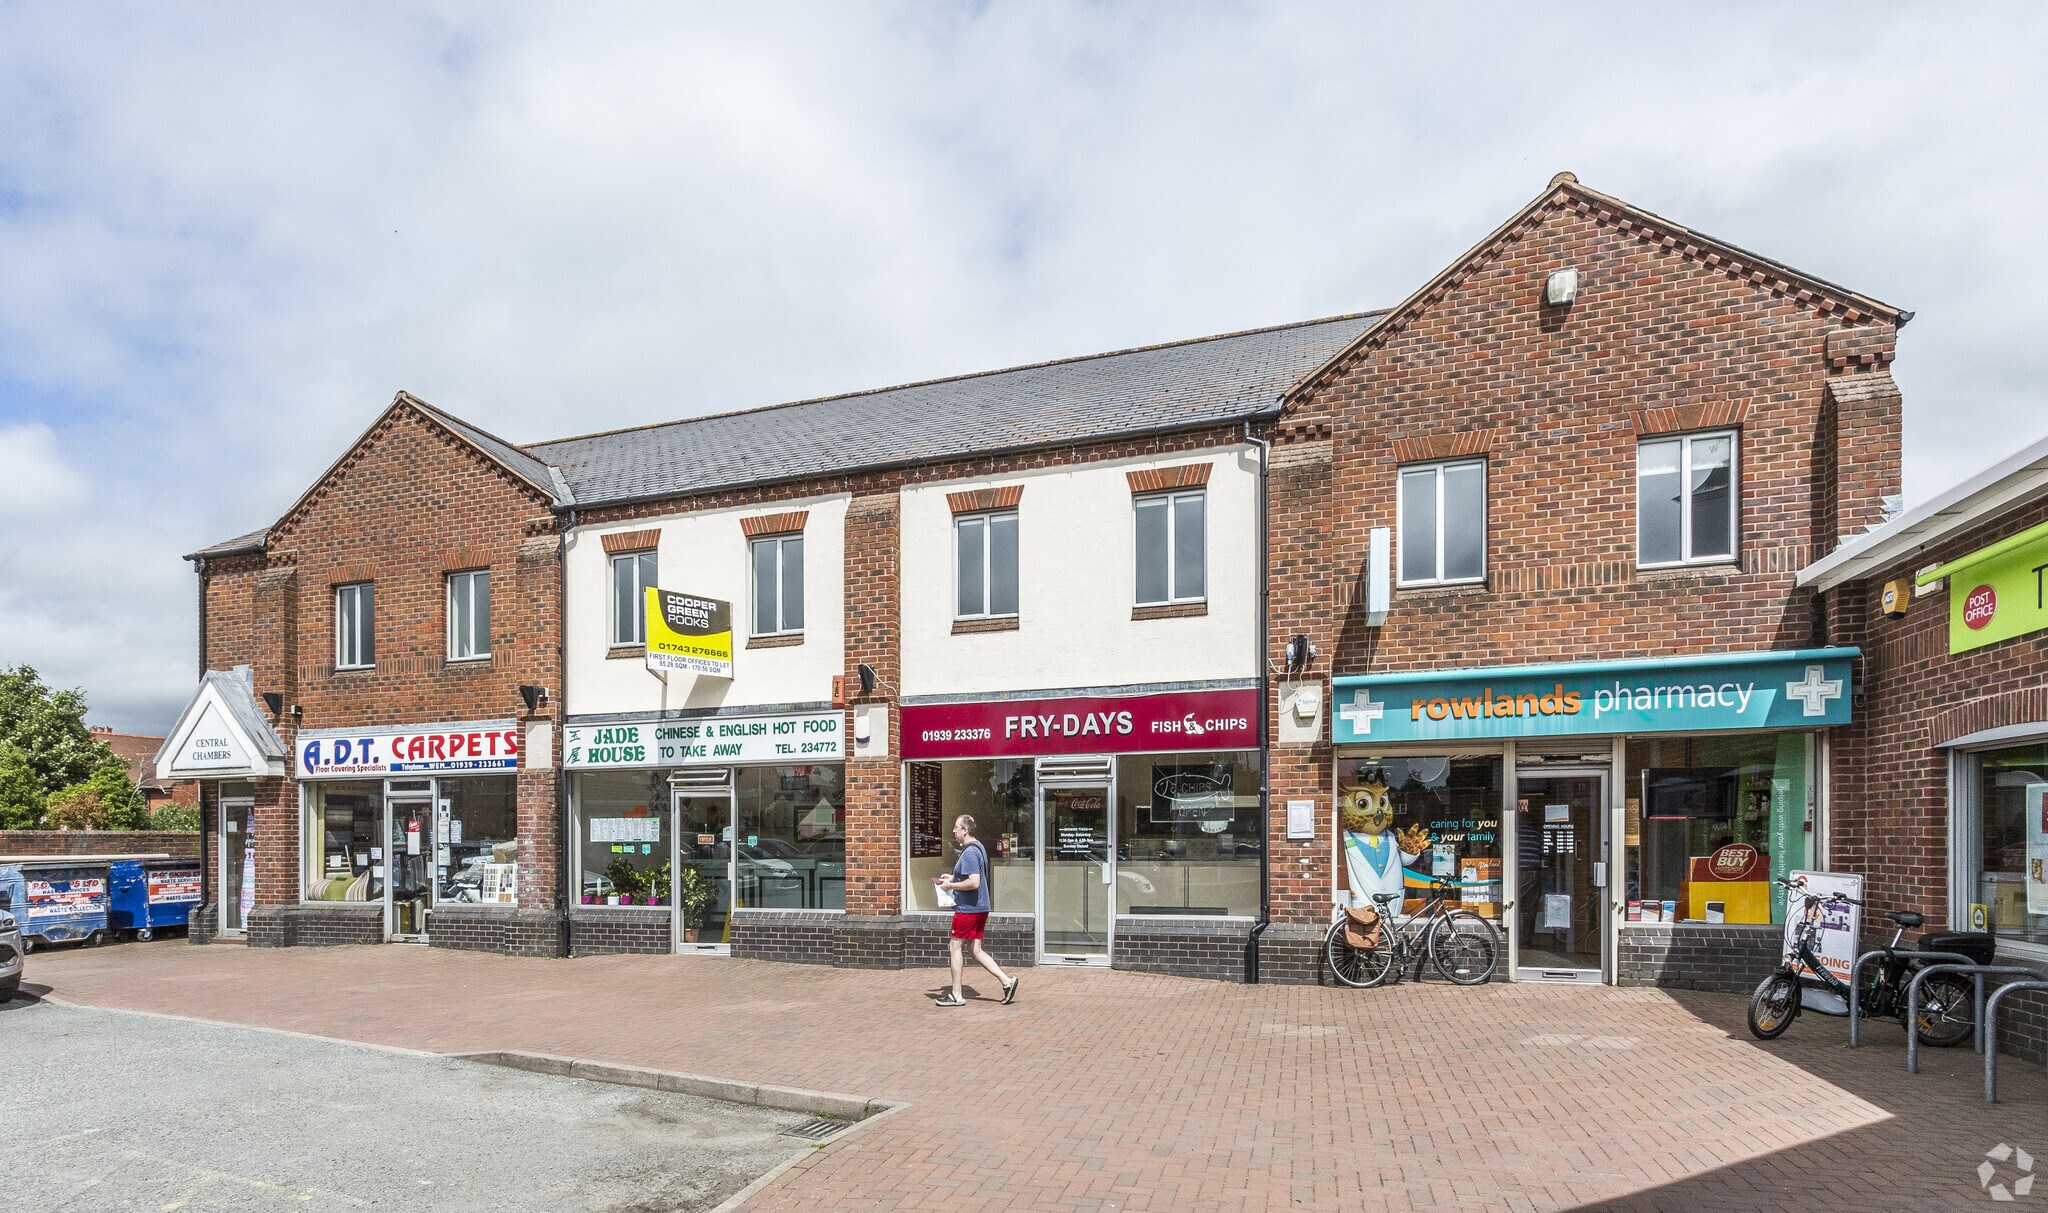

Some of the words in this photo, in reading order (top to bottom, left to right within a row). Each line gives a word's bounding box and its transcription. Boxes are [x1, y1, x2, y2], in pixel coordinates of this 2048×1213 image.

[666, 595, 717, 612] COOPER
[1969, 591, 1990, 609] POST
[667, 604, 709, 619] GREEN
[1965, 602, 1994, 622] OFFICE
[667, 614, 709, 628] POOKS
[658, 642, 690, 653] 01743
[691, 646, 728, 658] 276666
[649, 652, 665, 661] FIRST
[667, 655, 687, 663] FLOOR
[687, 657, 711, 666] OFFICES
[711, 659, 720, 667] TO
[719, 661, 730, 669] LET
[675, 662, 688, 670] SQM
[1411, 683, 1582, 721] rowlands
[1593, 681, 1755, 719] pharmacy
[655, 726, 700, 740] CHINESE
[706, 725, 714, 737] &
[719, 723, 767, 737] ENGLISH
[772, 721, 797, 735] HOT
[803, 719, 837, 733] FOOD
[1004, 711, 1134, 739] FRY-DAYS
[1151, 720, 1182, 733] FISH
[1205, 718, 1248, 731] CHIPS
[593, 727, 639, 745] JADE
[922, 729, 952, 742] 01939
[953, 728, 991, 741] 233376
[195, 738, 229, 748] CENTRAL
[660, 746, 675, 758] TO
[680, 745, 707, 758] TAKE
[713, 743, 743, 756] AWAY
[775, 743, 797, 754] TEL:
[801, 741, 837, 753] 234772
[192, 751, 232, 760] CHAMBERS
[303, 738, 379, 775] A.D.T.
[391, 731, 518, 761] CARPETS
[587, 745, 646, 763] HOUSE
[315, 765, 330, 773] Floor
[331, 765, 356, 773] Covering
[357, 764, 387, 773] Specialists
[450, 761, 473, 769] 01939
[478, 760, 506, 768] 233661
[1430, 819, 1459, 830] caring
[1461, 818, 1475, 828] for
[1477, 820, 1498, 830] you
[1777, 814, 1786, 831] with
[1430, 832, 1440, 842] &
[1440, 833, 1465, 843] your
[1467, 832, 1495, 843] family
[1776, 831, 1786, 849] your
[1720, 849, 1753, 857] BEST
[1716, 857, 1749, 867] BUY
[1815, 955, 1850, 970] OING
